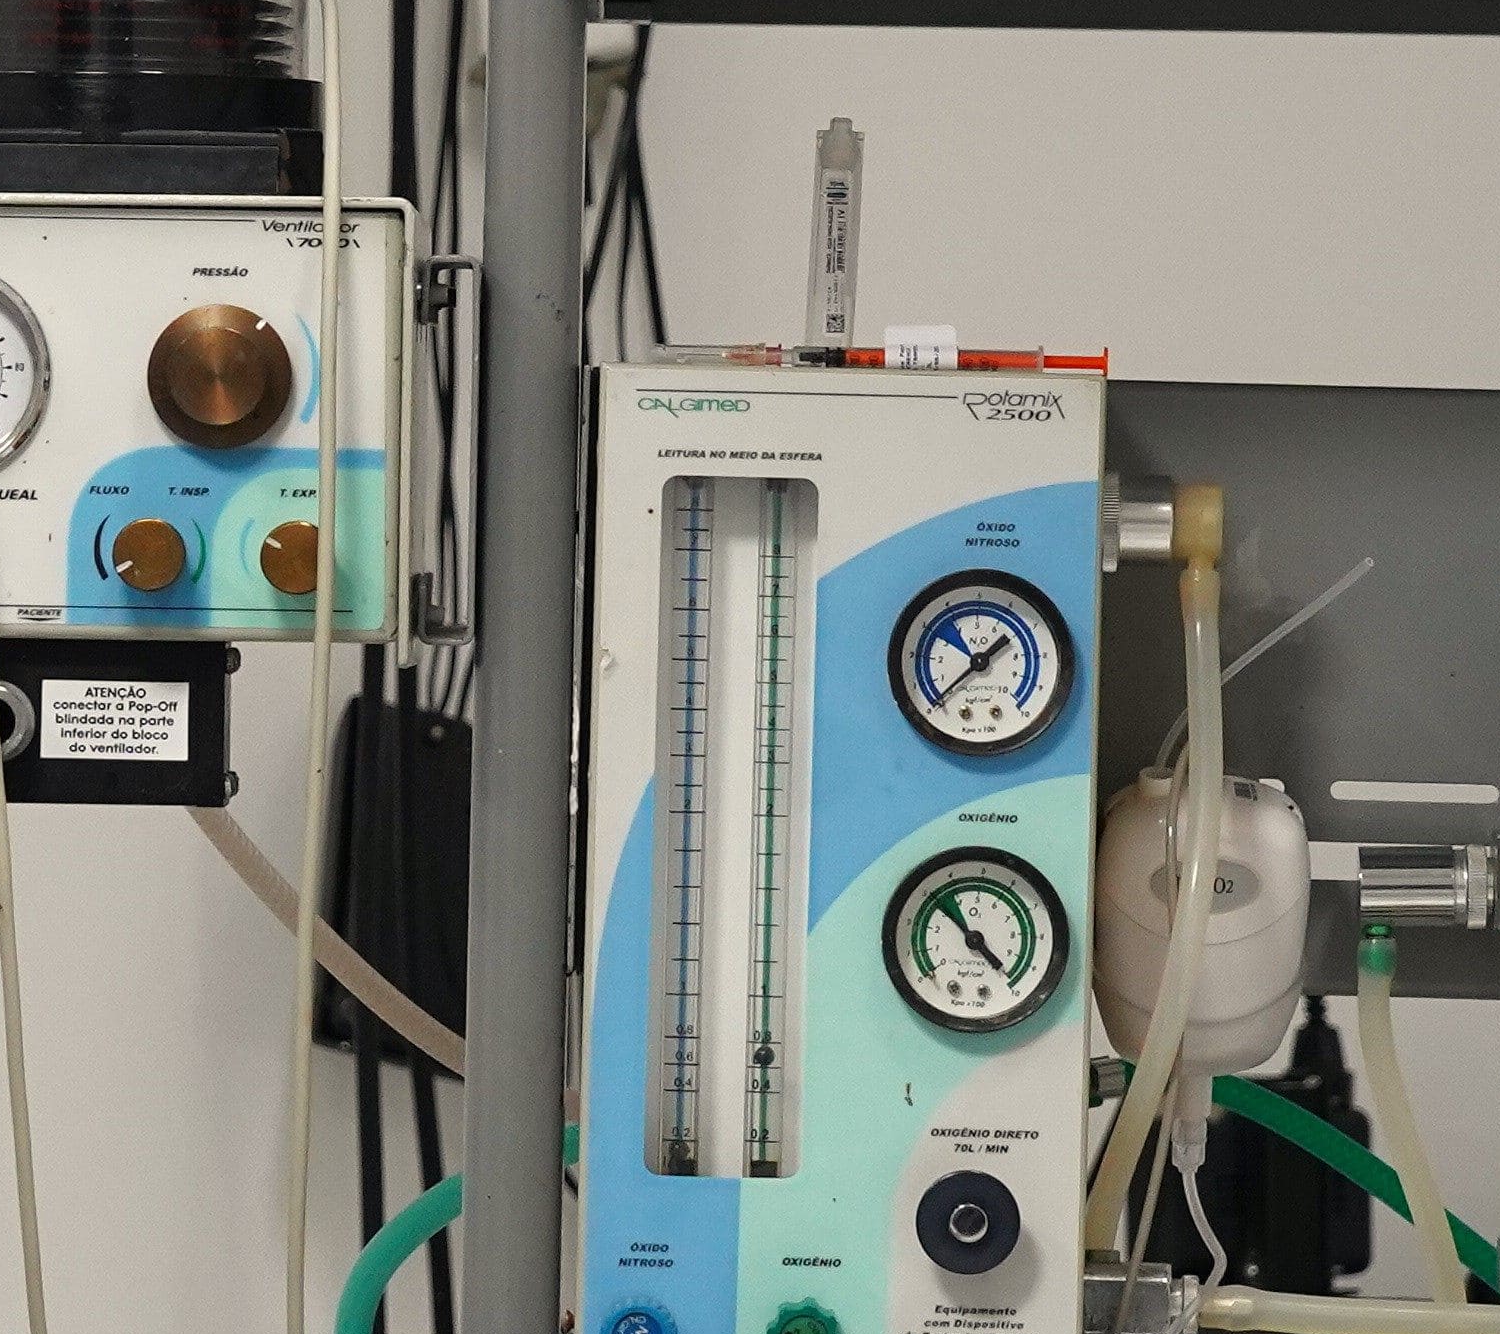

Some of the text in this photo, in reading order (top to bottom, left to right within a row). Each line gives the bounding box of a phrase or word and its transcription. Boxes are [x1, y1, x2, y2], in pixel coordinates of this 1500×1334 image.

[192, 265, 248, 278] PRESSÃO
[962, 390, 1066, 420] Rotamix
[985, 409, 1051, 421] 2500
[658, 449, 823, 461] LEITURA NO MEIO DA ESFERA
[90, 486, 129, 495] FLUXO
[977, 522, 1016, 532] ÓXIDO
[965, 538, 1020, 547] NITROSO
[17, 608, 62, 617] PACIENTE
[85, 686, 146, 699] ATENÇÃO
[53, 700, 111, 710] conectar
[128, 701, 178, 713] Pop-Off
[55, 713, 174, 727] blindada na parte
[111, 729, 128, 739] do
[132, 730, 168, 740] bloco
[69, 743, 159, 754] do ventilador.
[958, 813, 1018, 823] OXIGÊNIO
[931, 1128, 1039, 1140] OXIGÊNIO DIRETO
[954, 1143, 975, 1153] 70L
[985, 1144, 1009, 1154] MIN
[630, 1242, 669, 1253] ÓXIDO
[618, 1257, 674, 1267] NITROSO
[782, 1256, 842, 1267] OXIGÊNIO
[934, 1305, 1017, 1316] Equipamento
[924, 1319, 1024, 1330] com Dispositivo
